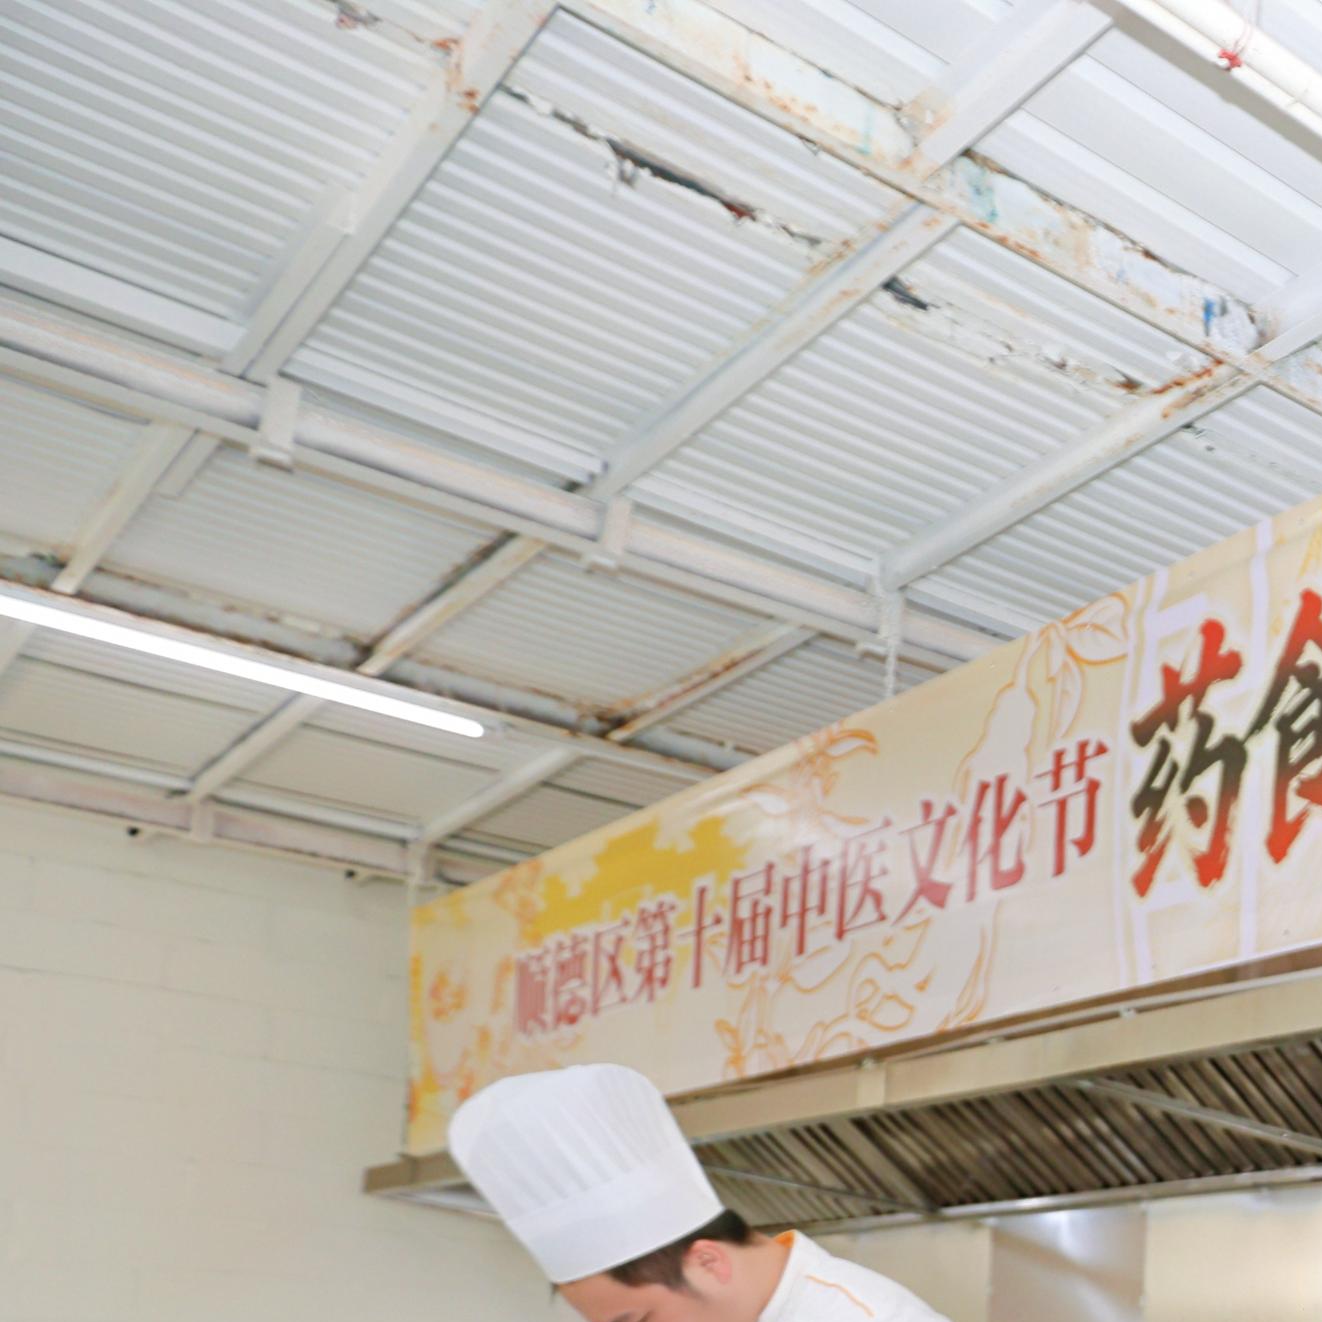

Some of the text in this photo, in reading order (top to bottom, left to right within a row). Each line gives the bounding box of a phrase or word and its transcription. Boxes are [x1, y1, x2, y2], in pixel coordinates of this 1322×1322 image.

[514, 738, 1109, 1036] 顺德区第十届中医文化节
